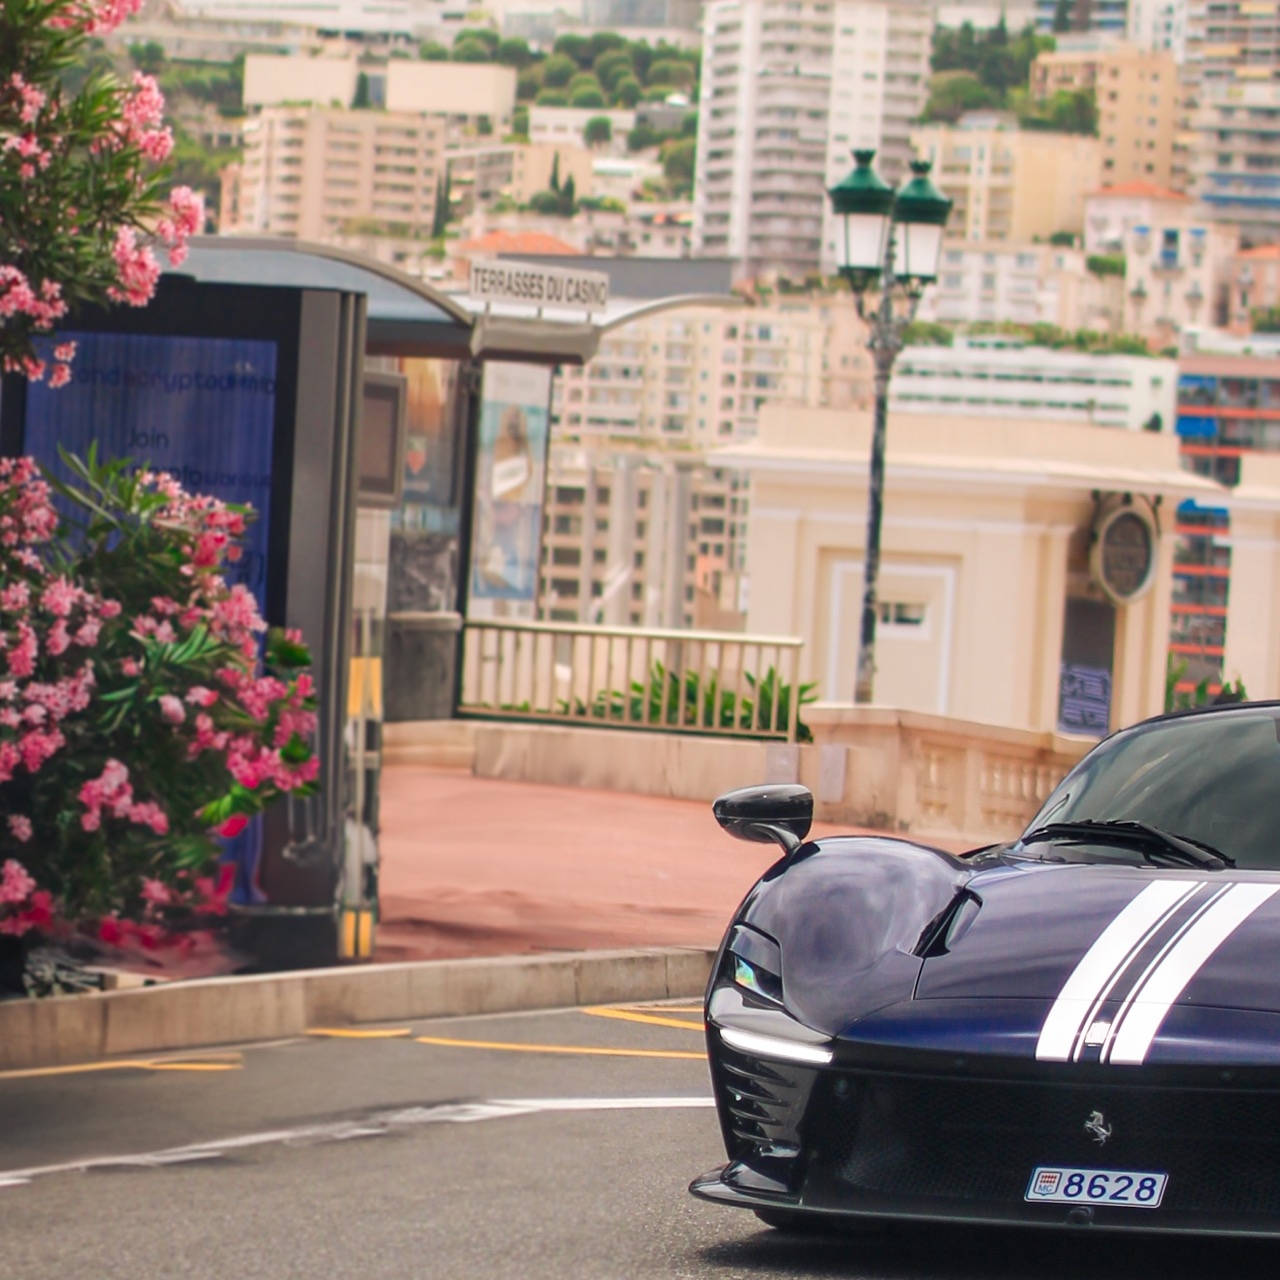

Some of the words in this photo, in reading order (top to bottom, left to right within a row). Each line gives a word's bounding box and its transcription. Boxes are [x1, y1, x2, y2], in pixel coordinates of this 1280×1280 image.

[473, 268, 544, 299] TERRASSES
[547, 276, 563, 302] DU
[566, 278, 606, 306] CASINO
[128, 428, 169, 449] Join
[1038, 1185, 1053, 1193] MC
[1063, 1173, 1157, 1202] 8628
